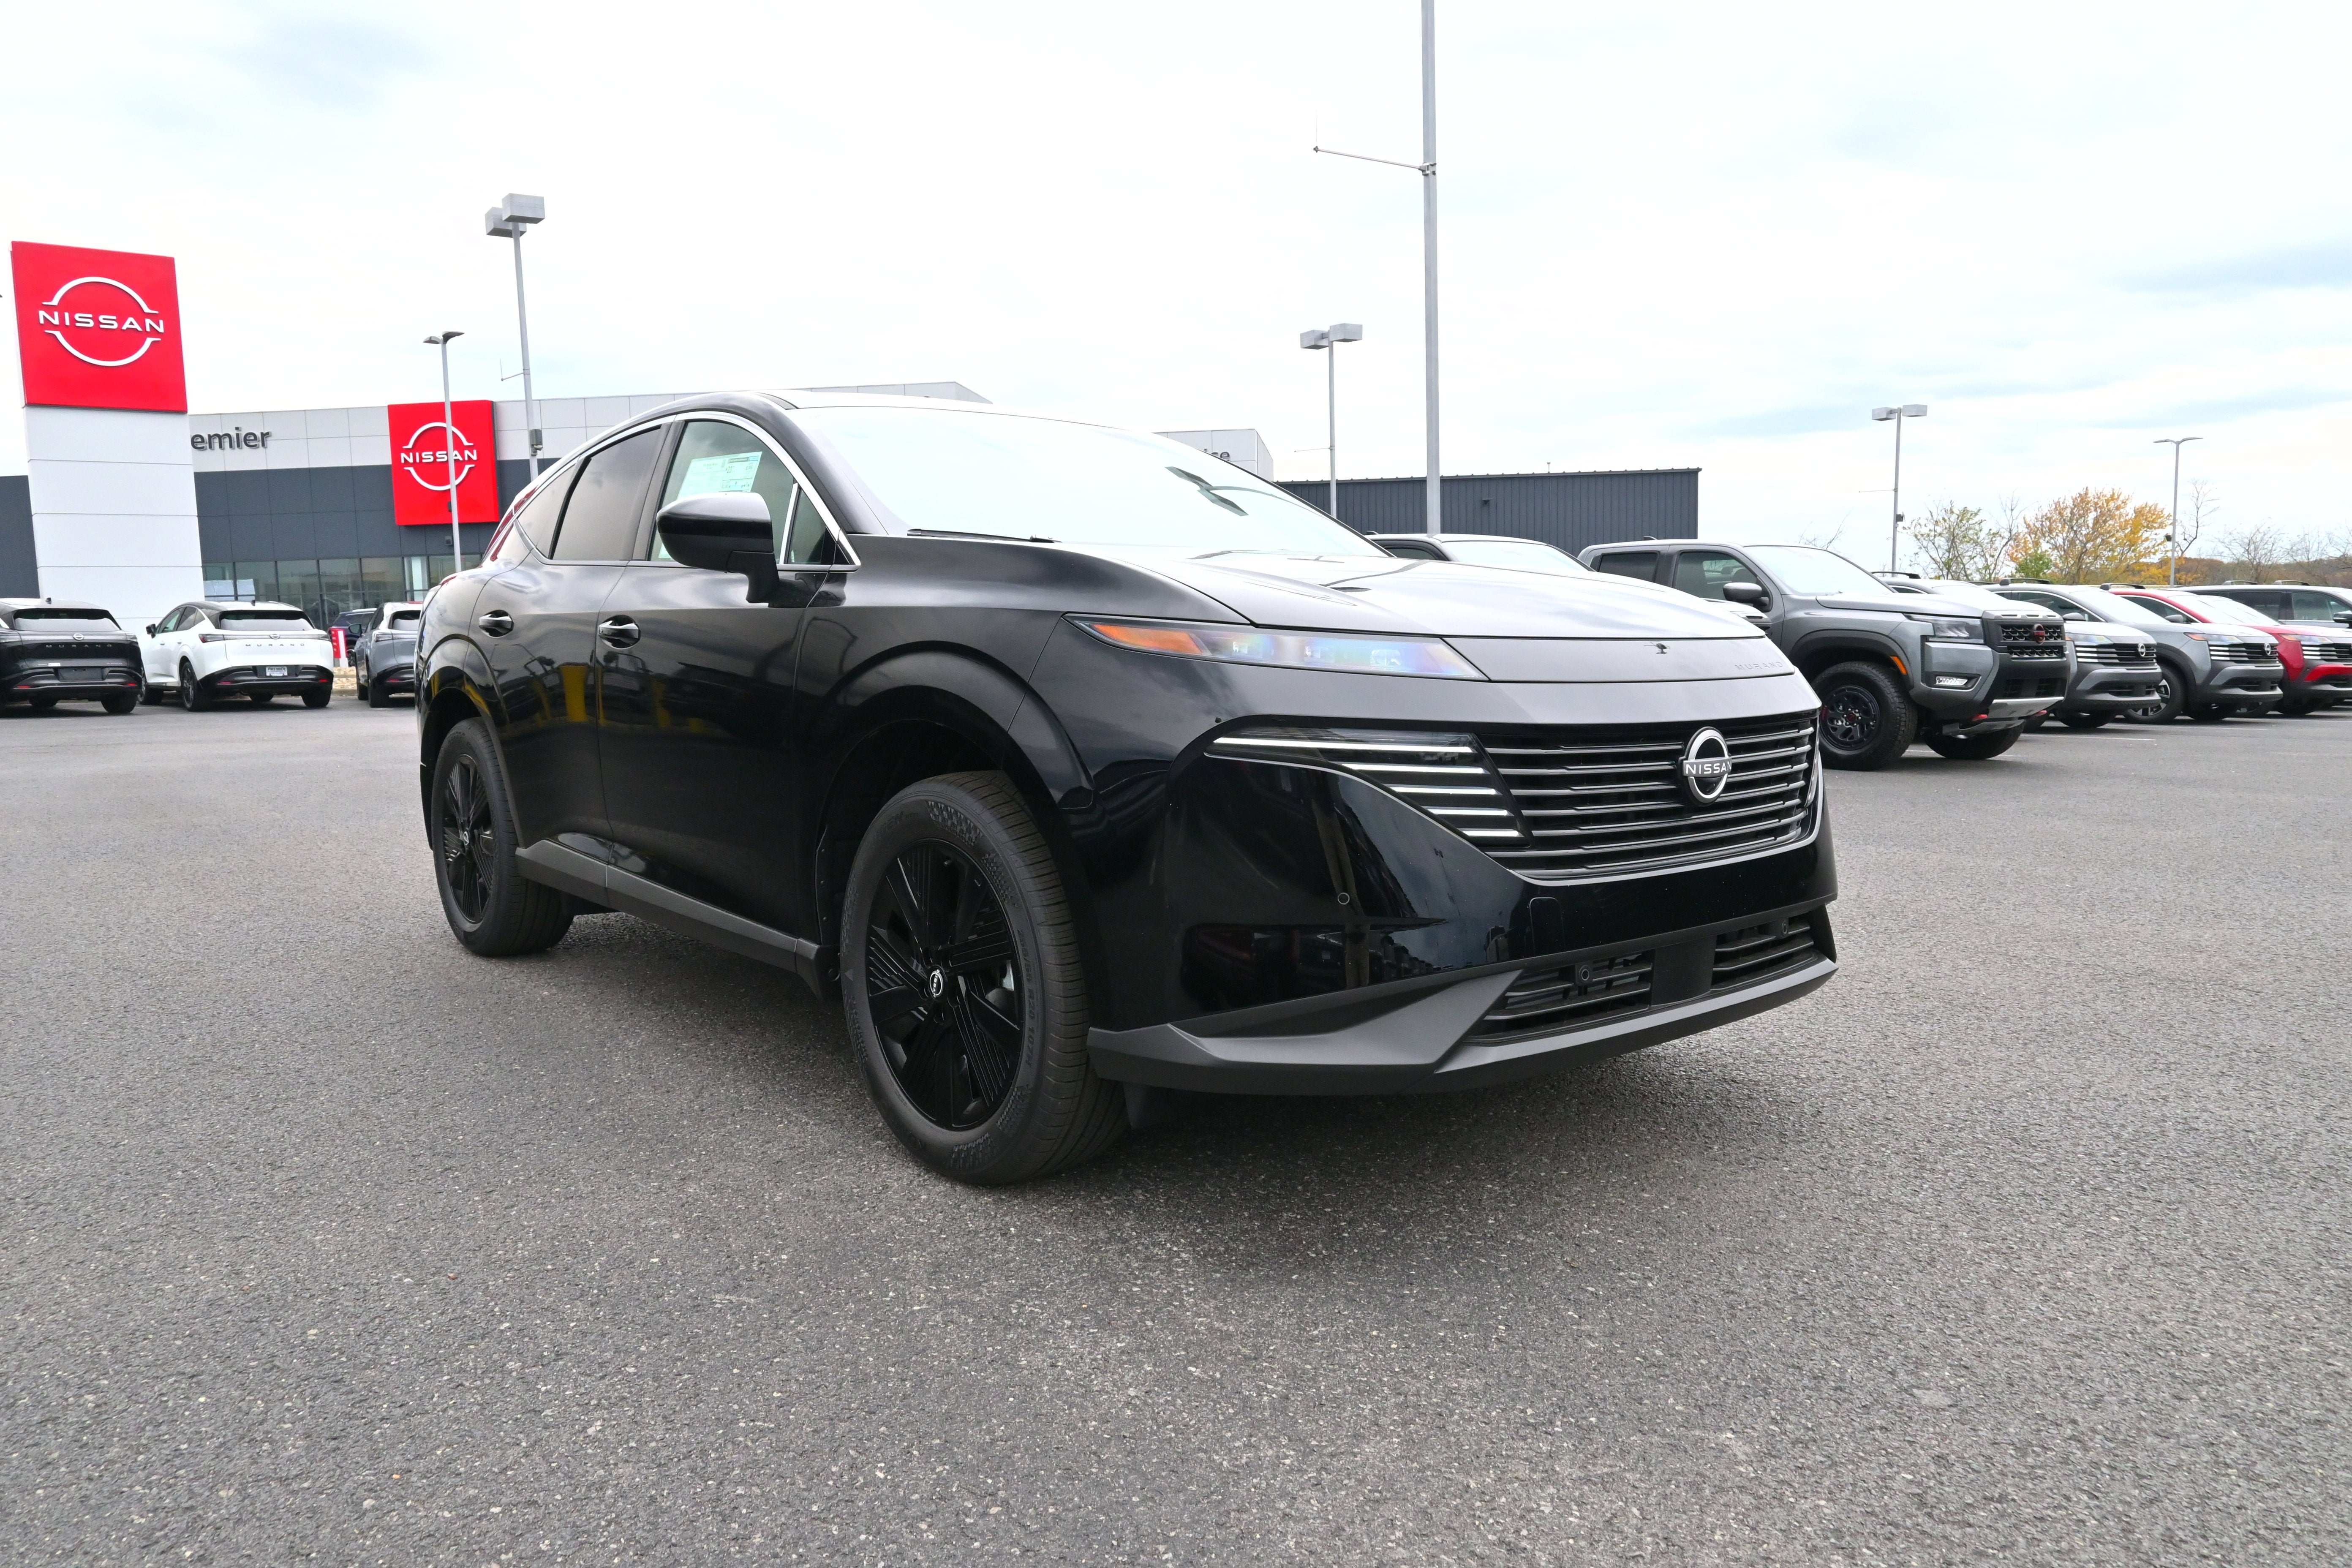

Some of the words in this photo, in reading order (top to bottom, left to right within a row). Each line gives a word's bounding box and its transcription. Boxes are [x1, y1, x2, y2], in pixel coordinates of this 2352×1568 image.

[38, 310, 164, 333] NISSAN
[400, 449, 477, 463] NISSAN
[1735, 662, 1783, 670] MURANO
[1686, 760, 1731, 774] NISSAN
